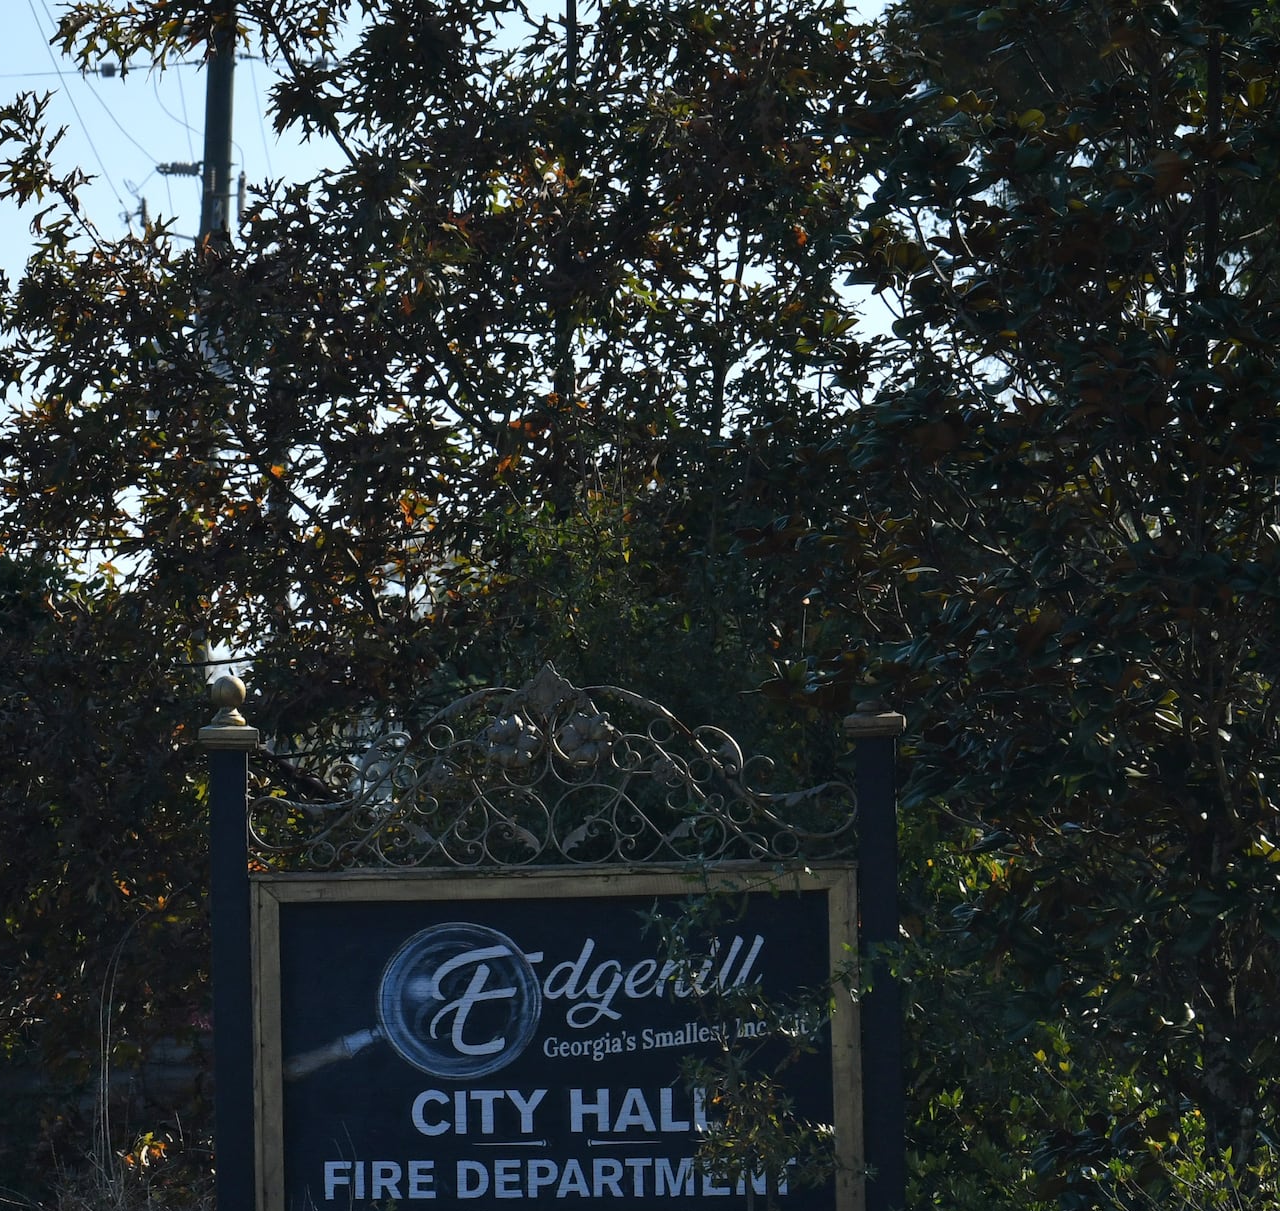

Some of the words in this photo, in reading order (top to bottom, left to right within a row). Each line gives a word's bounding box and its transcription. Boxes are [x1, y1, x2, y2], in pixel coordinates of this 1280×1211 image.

[542, 1030, 637, 1061] Georgia's
[411, 1088, 549, 1137] CITY
[569, 1087, 722, 1133] HALL
[323, 1160, 437, 1201] FIRE
